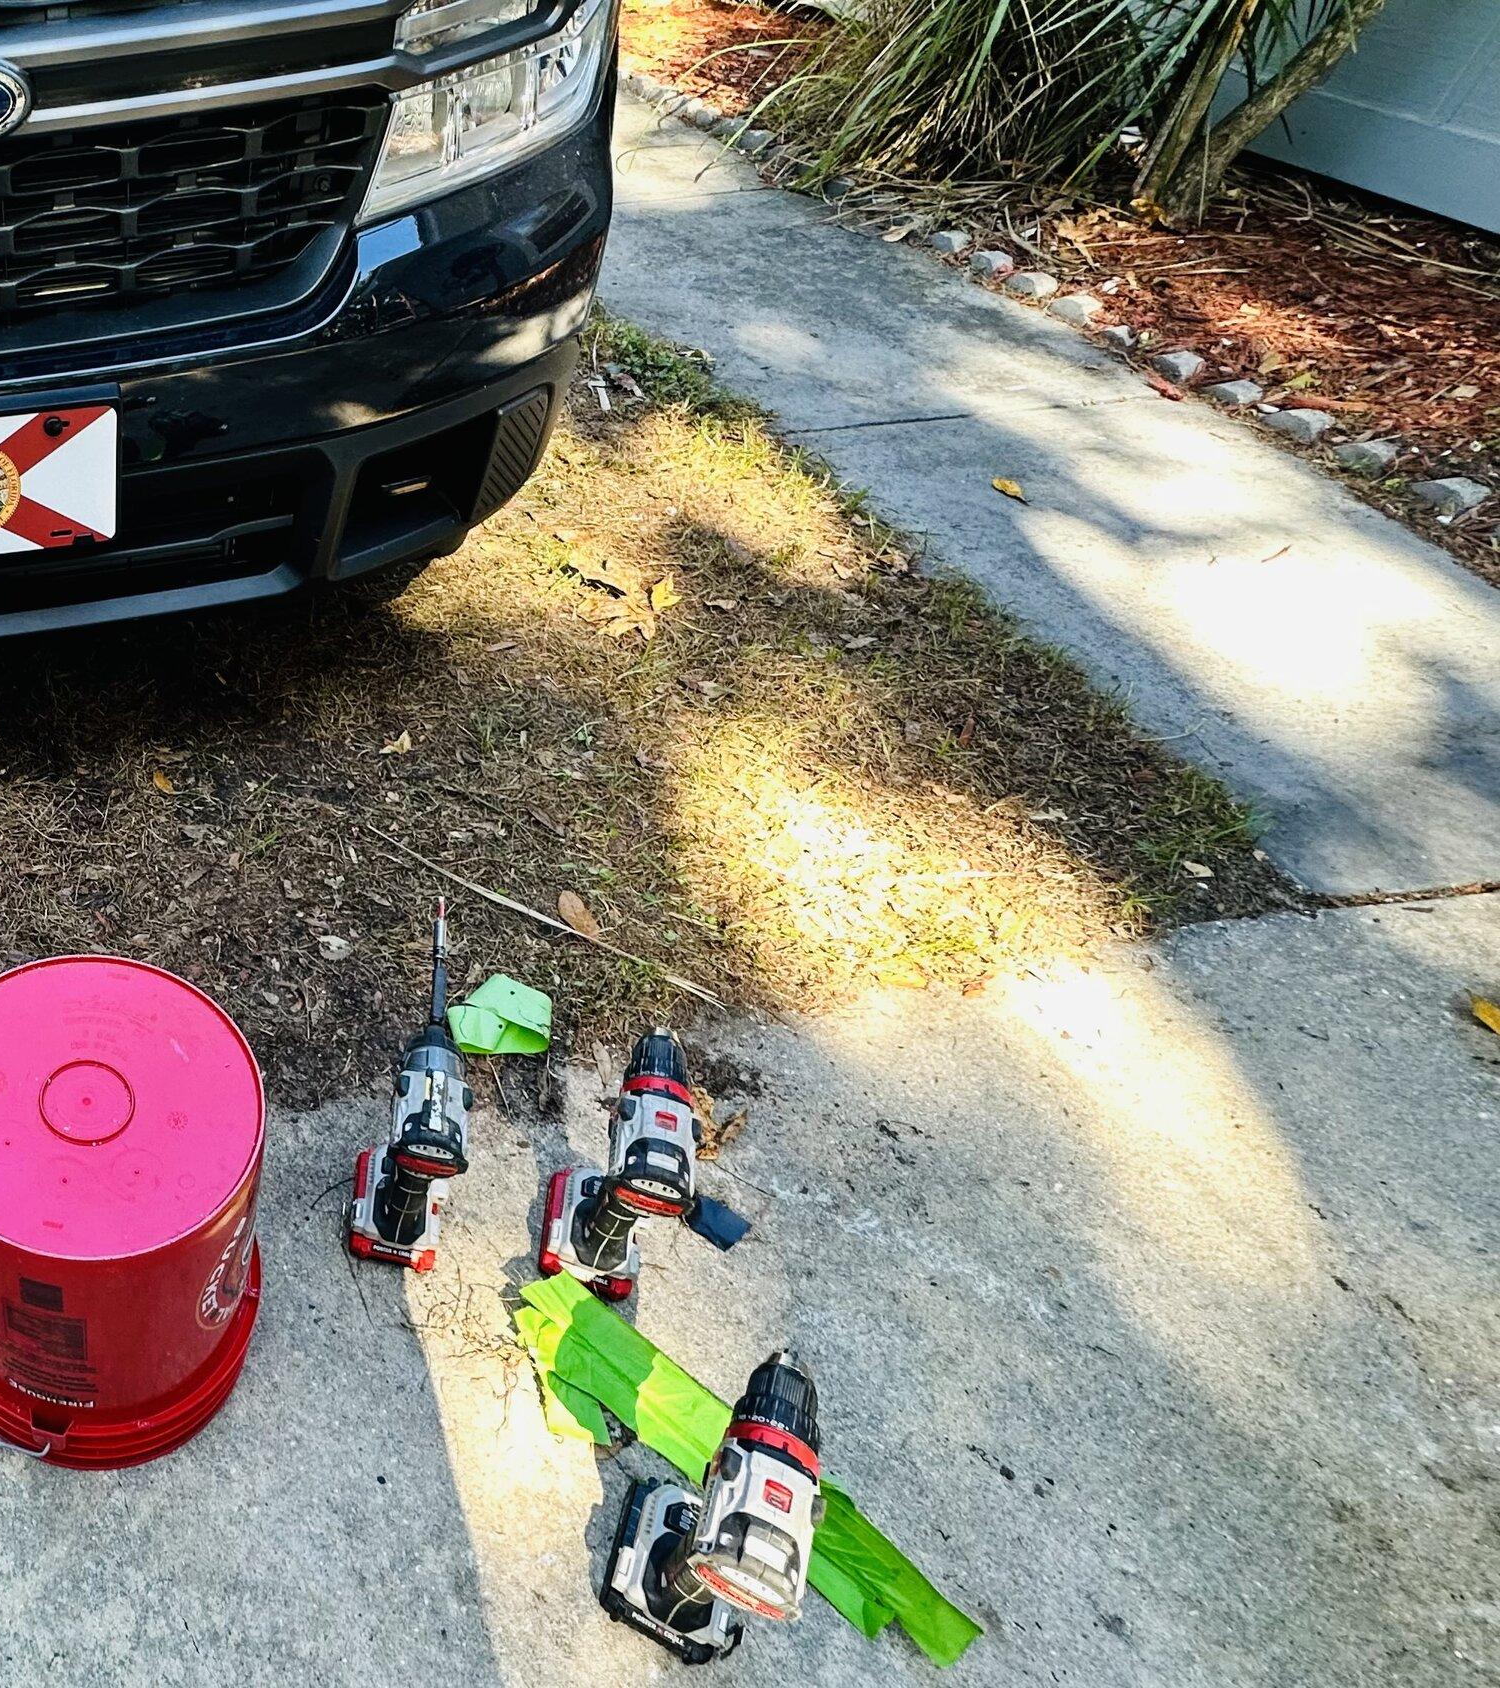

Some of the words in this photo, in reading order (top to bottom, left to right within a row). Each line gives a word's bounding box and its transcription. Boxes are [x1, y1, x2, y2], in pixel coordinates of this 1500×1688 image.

[6, 467, 19, 508] FLORIDA
[7, 1377, 95, 1408] FIREHOUSE
[631, 1611, 657, 1630] PORTER
